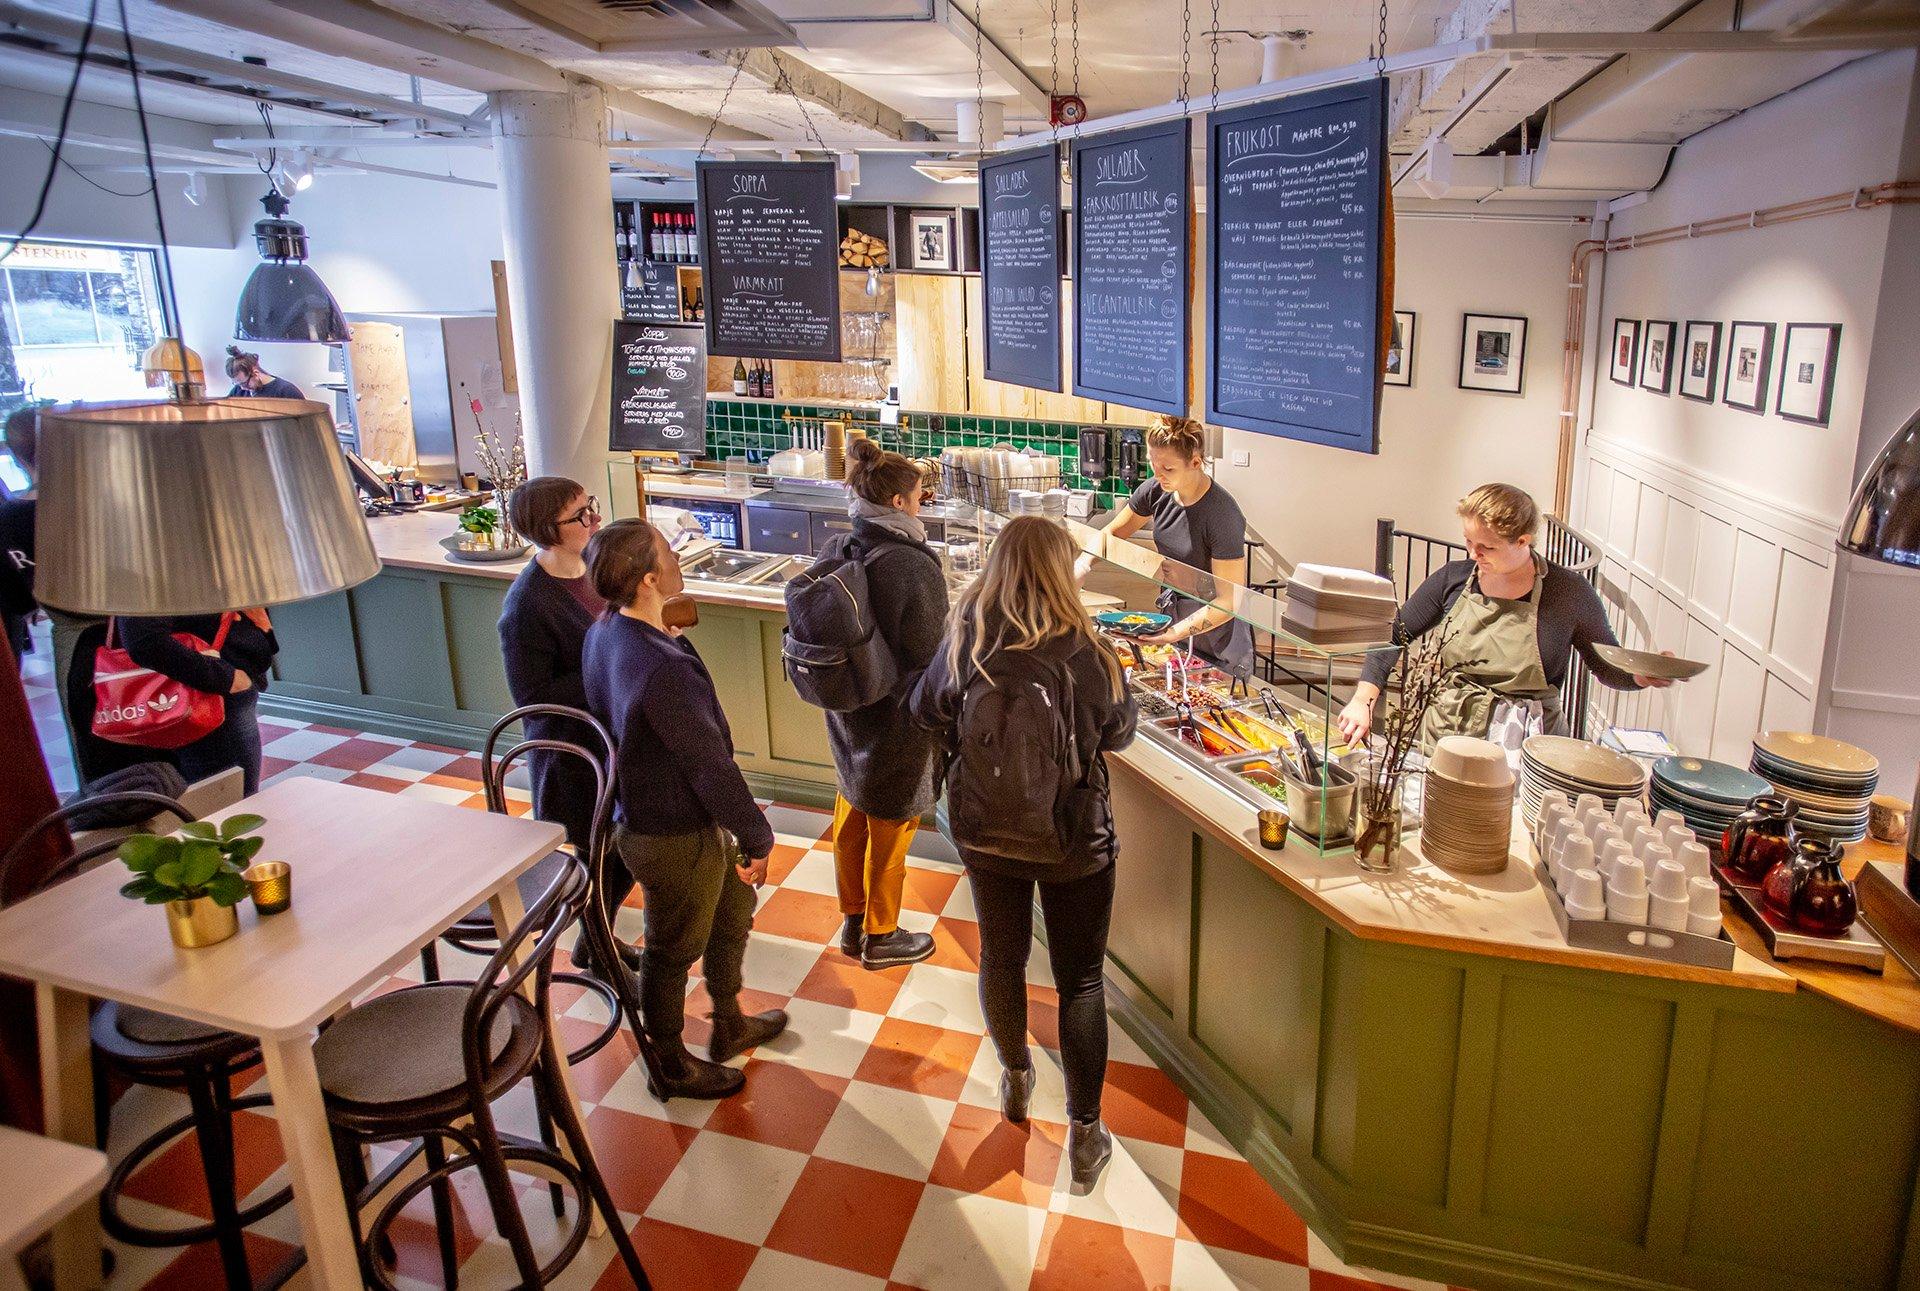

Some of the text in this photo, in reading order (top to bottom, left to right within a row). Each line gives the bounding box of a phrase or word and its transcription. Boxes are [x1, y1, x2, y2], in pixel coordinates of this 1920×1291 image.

[1227, 125, 1282, 157] FRUKOST
[1097, 149, 1145, 179] SALLADER
[732, 175, 767, 192] SOPPA
[96, 704, 146, 724] adidas
